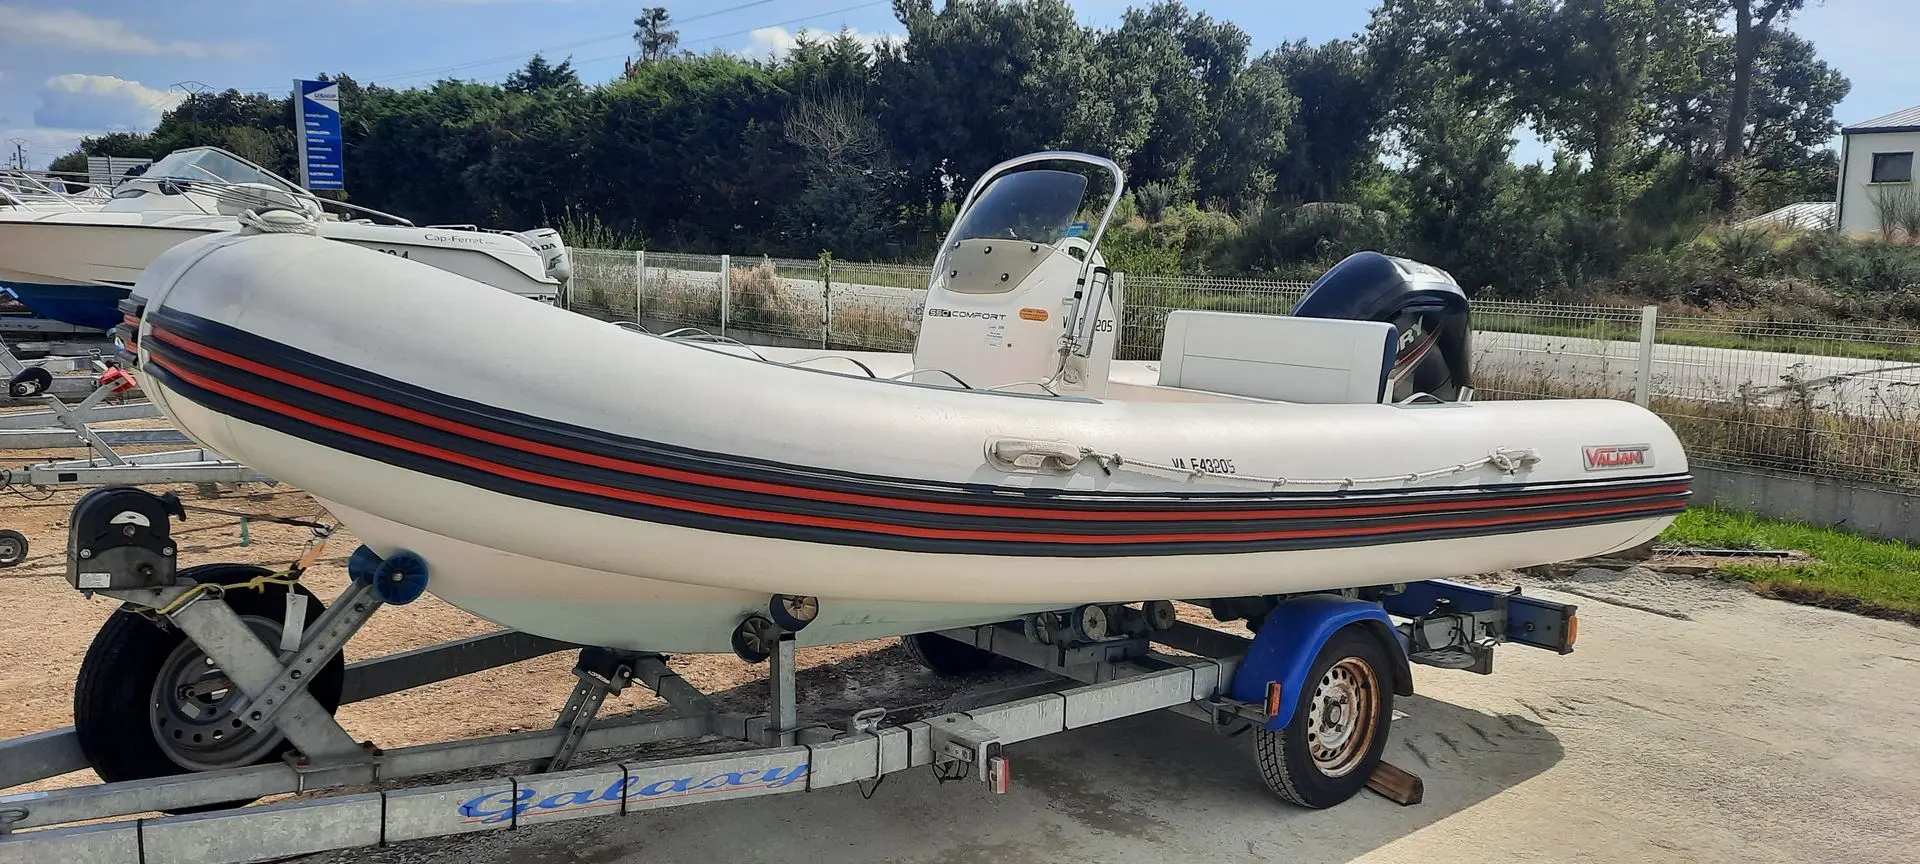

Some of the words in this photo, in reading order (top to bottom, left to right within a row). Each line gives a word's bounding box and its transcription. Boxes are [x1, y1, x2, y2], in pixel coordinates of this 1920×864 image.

[952, 310, 1006, 320] COMFORT
[1396, 315, 1423, 354] RY
[1171, 458, 1185, 469] VA
[1586, 446, 1650, 467] VALIANT
[458, 764, 817, 824] Galaxy
